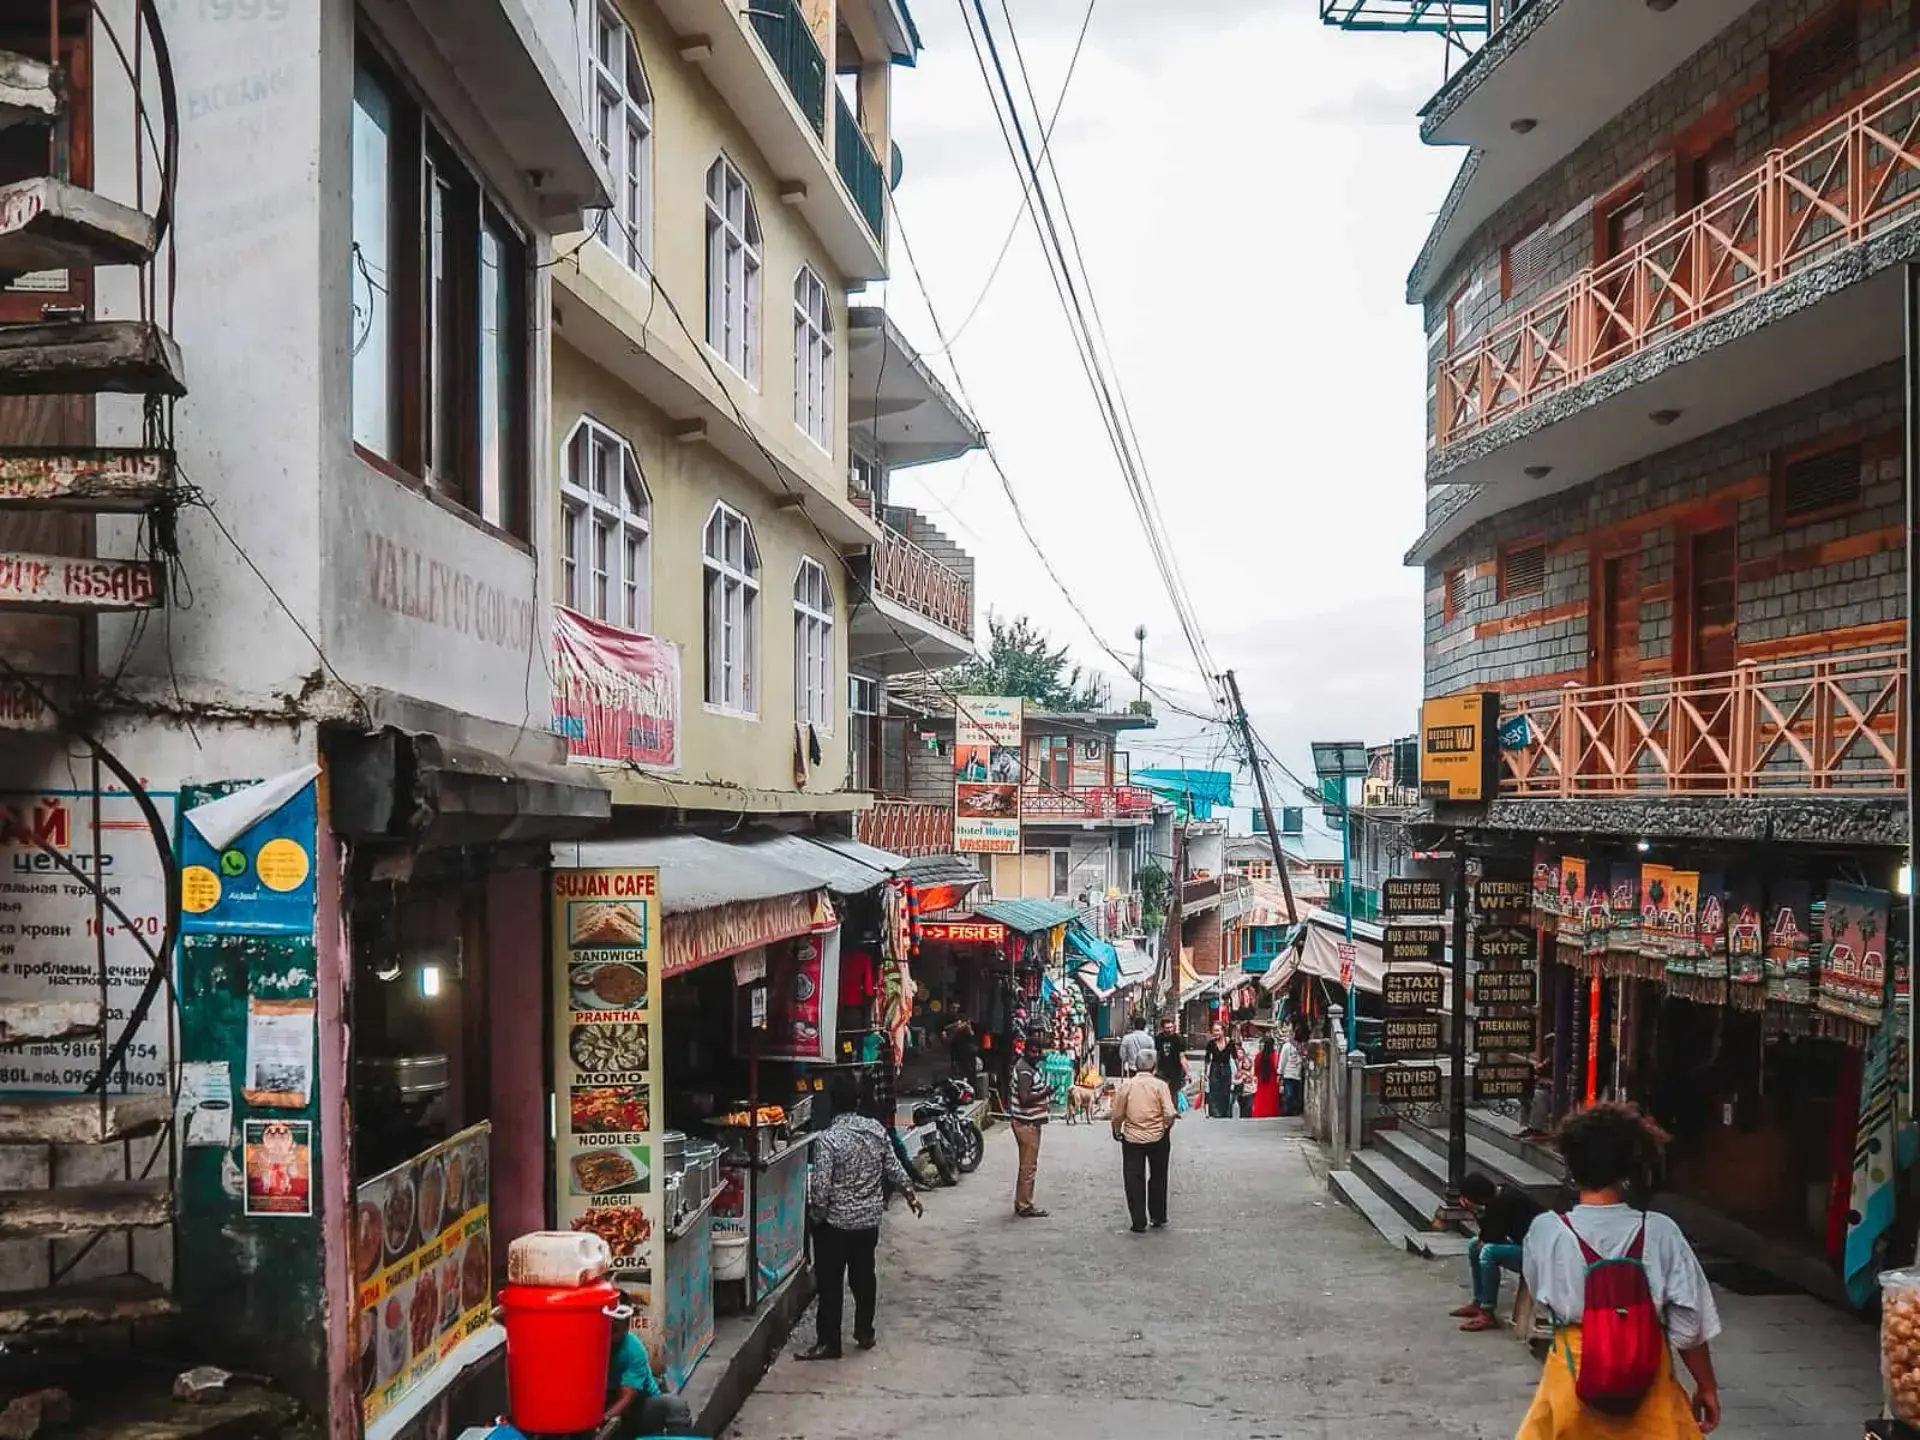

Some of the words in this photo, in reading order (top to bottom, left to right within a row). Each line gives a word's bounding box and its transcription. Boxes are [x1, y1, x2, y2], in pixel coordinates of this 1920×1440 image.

[365, 531, 450, 628] VALLEY
[957, 825, 983, 835] Hotel
[556, 874, 610, 897] SUJAN
[613, 874, 656, 896] CAFE
[1388, 882, 1412, 895] VALLEY
[1412, 882, 1422, 895] OF
[20, 923, 71, 939] крови
[949, 925, 984, 939] FISH
[1393, 944, 1429, 957] BOOKING
[1482, 942, 1528, 956] SKYPE
[573, 950, 645, 962] SANDWICH
[1402, 976, 1440, 990] TAXI
[1478, 974, 1503, 987] PRINT
[1386, 990, 1439, 1004] SERVICE
[575, 1011, 642, 1023] PRANTHA
[1386, 1023, 1405, 1036] CASH
[1407, 1023, 1417, 1036] ON
[1478, 1020, 1532, 1032] TREKKING
[1386, 1037, 1415, 1050] CREDIT
[1416, 1037, 1438, 1050] CARD
[575, 1072, 643, 1085] MOMO
[1385, 1070, 1437, 1084] STD/ISD
[1385, 1085, 1409, 1098] CALL
[1410, 1085, 1436, 1098] BACK
[1482, 1082, 1523, 1094] RAFTING
[578, 1133, 641, 1147] NOODLES
[590, 1194, 632, 1207] MAGGI
[607, 1257, 648, 1269] ORA
[629, 1317, 650, 1330] ICE
